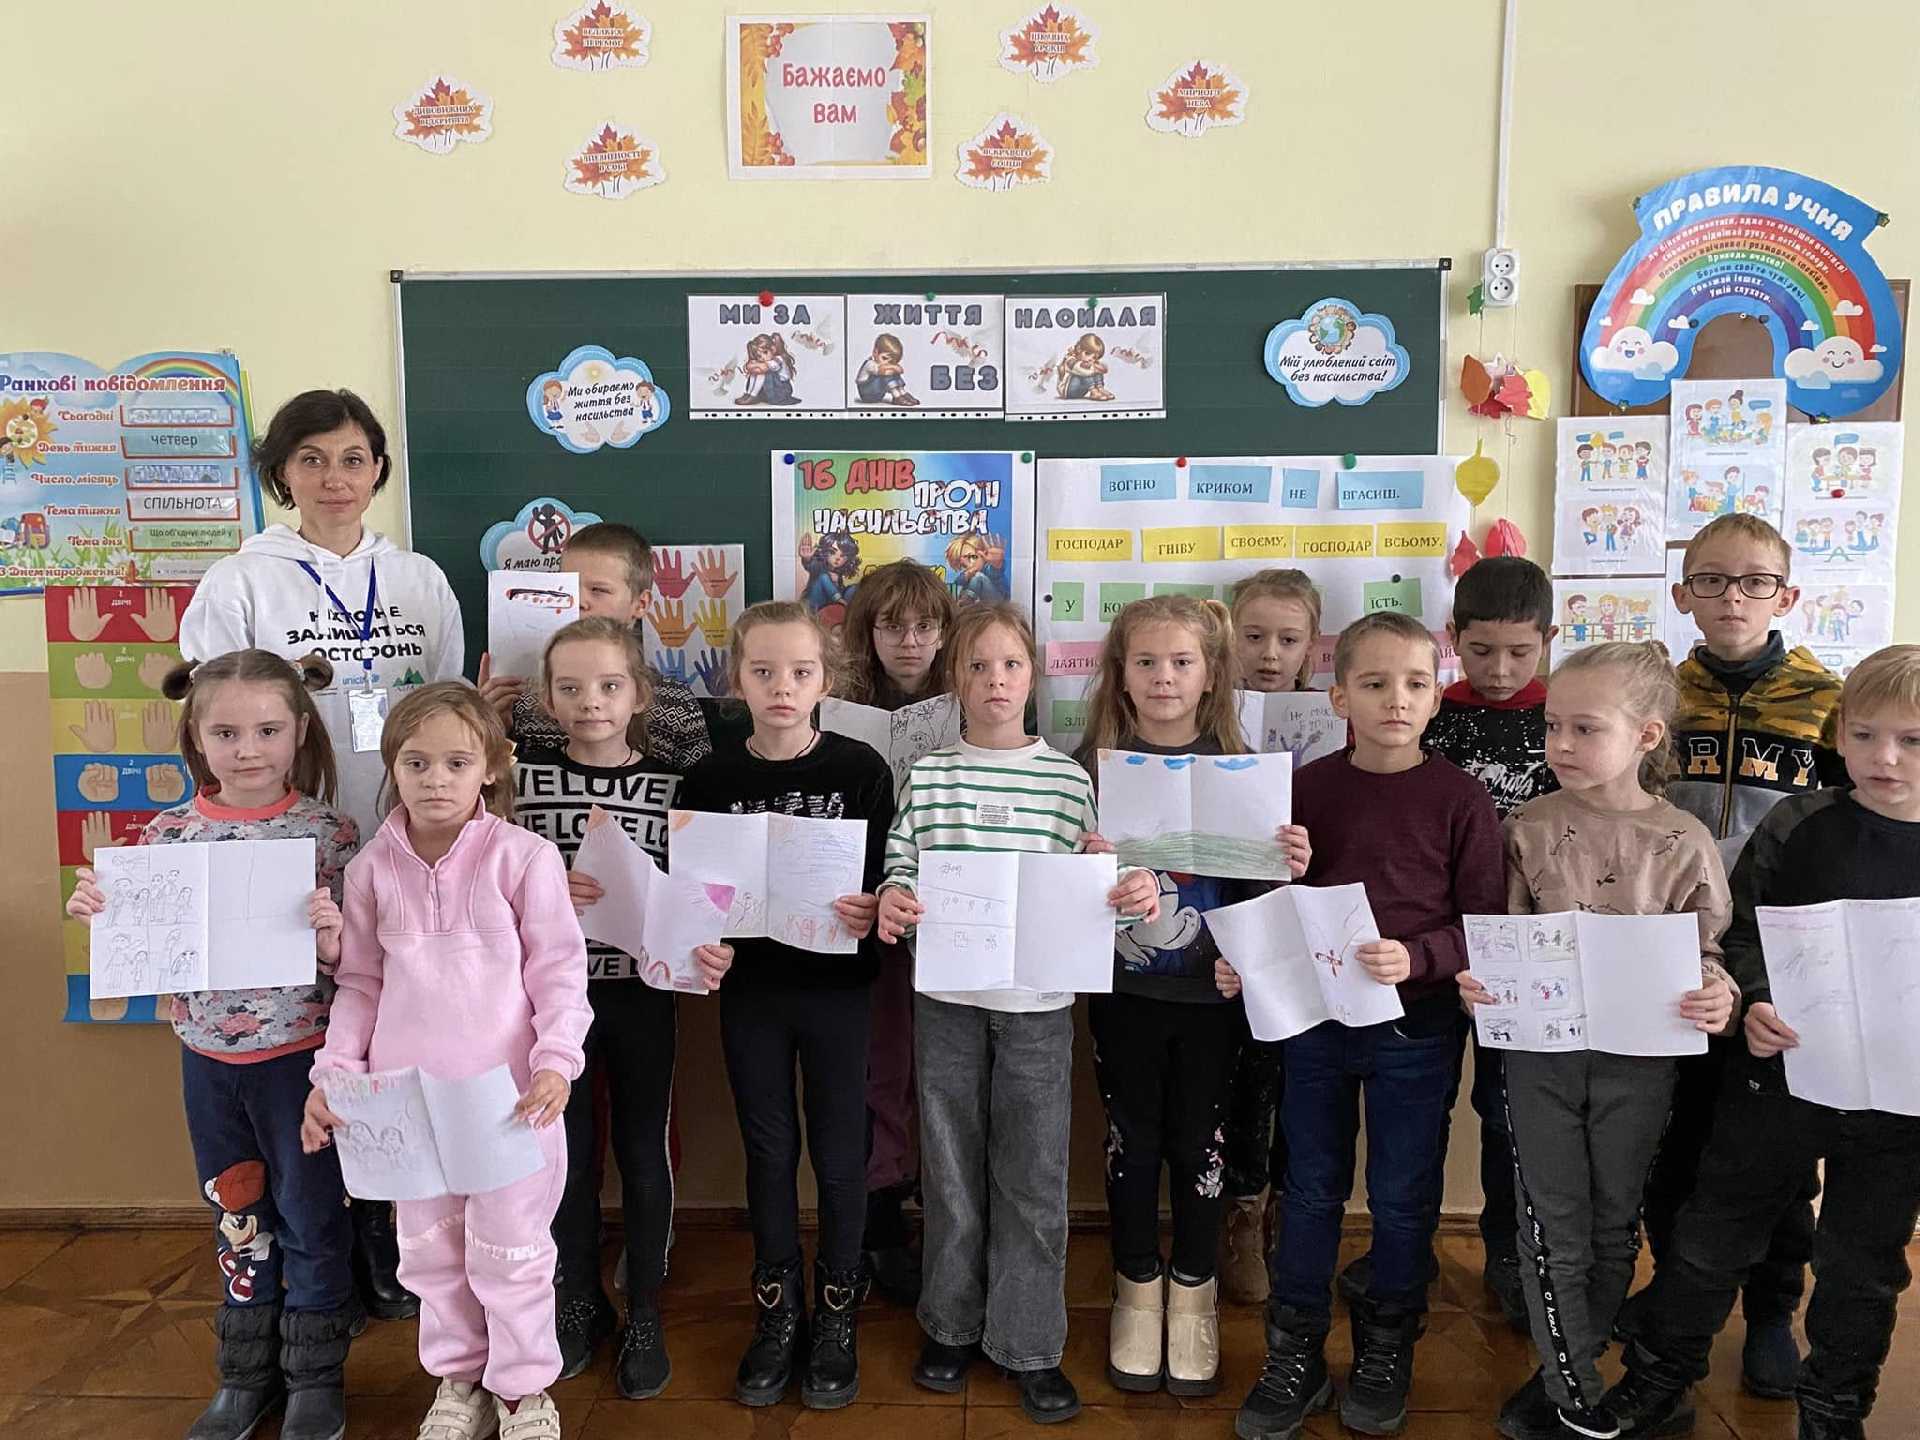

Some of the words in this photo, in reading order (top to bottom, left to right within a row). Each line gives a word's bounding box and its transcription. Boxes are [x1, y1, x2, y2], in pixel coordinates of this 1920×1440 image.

[782, 62, 886, 88] Бажаємо
[813, 102, 857, 124] вам
[1653, 183, 1779, 231] ПРАВИЛА
[1784, 190, 1854, 241] УЧНЯ
[719, 303, 761, 325] МИ
[773, 303, 811, 325] ЗА
[873, 303, 983, 326] ЖИТТЯ
[1014, 306, 1157, 329] НАСИЛЛЯ
[1279, 355, 1303, 368] Мій
[1303, 354, 1367, 371] улюблений
[1368, 353, 1396, 368] світ
[0, 374, 76, 392] Ранкові
[84, 374, 226, 392] повідомлення
[929, 364, 998, 391] БЕЗ
[1290, 368, 1310, 382] без
[1313, 370, 1388, 383] насильства!
[567, 385, 583, 398] Ми
[584, 381, 635, 397] обираємо
[573, 397, 612, 410] життя
[614, 392, 632, 406] без
[58, 410, 114, 421] Сьогодні
[575, 406, 634, 422] насильства
[38, 442, 71, 452] День
[72, 442, 117, 452] тижня
[151, 435, 198, 448] четвер
[797, 458, 837, 490] 16
[845, 458, 915, 495] ДНІВ
[913, 480, 1001, 509] ПРОТИ
[1109, 479, 1156, 492] ВОГНЮ
[1196, 482, 1253, 494] КРИКОМ
[1288, 488, 1308, 499] НЕ
[1342, 488, 1400, 501] ВГАСИШ.
[44, 505, 76, 515] Тема
[77, 505, 121, 516] тижня
[143, 496, 223, 510] СПІЛЬНОТА
[812, 508, 989, 535] НАСИЛЬСТВА
[67, 535, 100, 547] Тема
[102, 536, 123, 547] дня
[1055, 538, 1124, 550] ГОСПОДАР
[1158, 542, 1197, 556] ГНІВУ
[1230, 536, 1287, 549] СВОЄМУ,
[1303, 541, 1372, 554] ГОСПОДАР
[1384, 537, 1443, 549] ВСЬОМУ.
[9, 567, 45, 577] Днем
[45, 566, 125, 579] народження!
[504, 558, 512, 570] Я
[513, 557, 541, 569] маю
[1065, 600, 1076, 613] У
[1104, 602, 1121, 613] КО
[1687, 737, 1815, 787] RMY
[560, 769, 669, 805] LOVE
